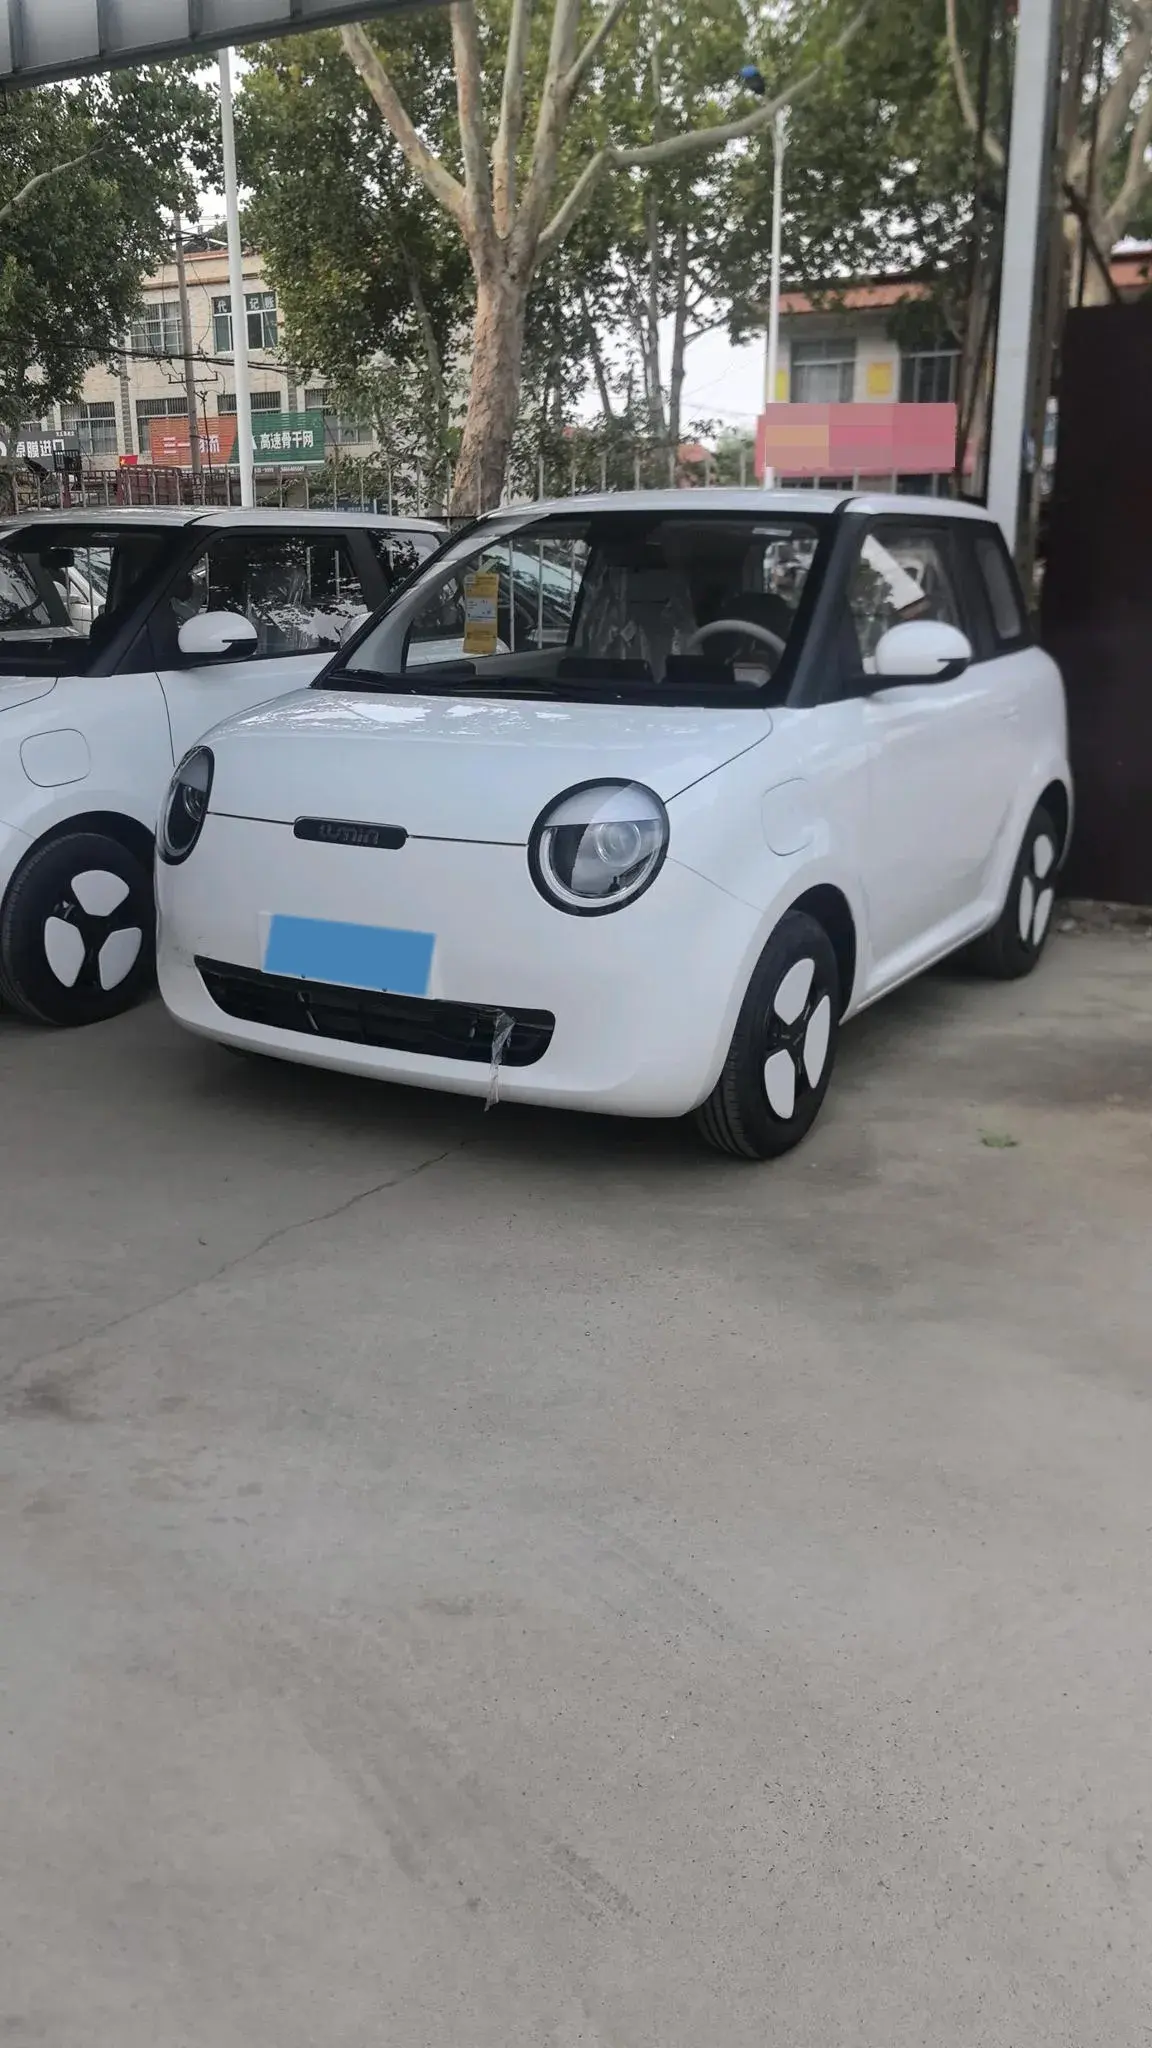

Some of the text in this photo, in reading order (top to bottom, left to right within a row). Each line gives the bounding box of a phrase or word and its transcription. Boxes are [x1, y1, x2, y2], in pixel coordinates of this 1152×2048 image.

[217, 296, 275, 312] 代记账
[260, 430, 314, 450] 高速骨干网
